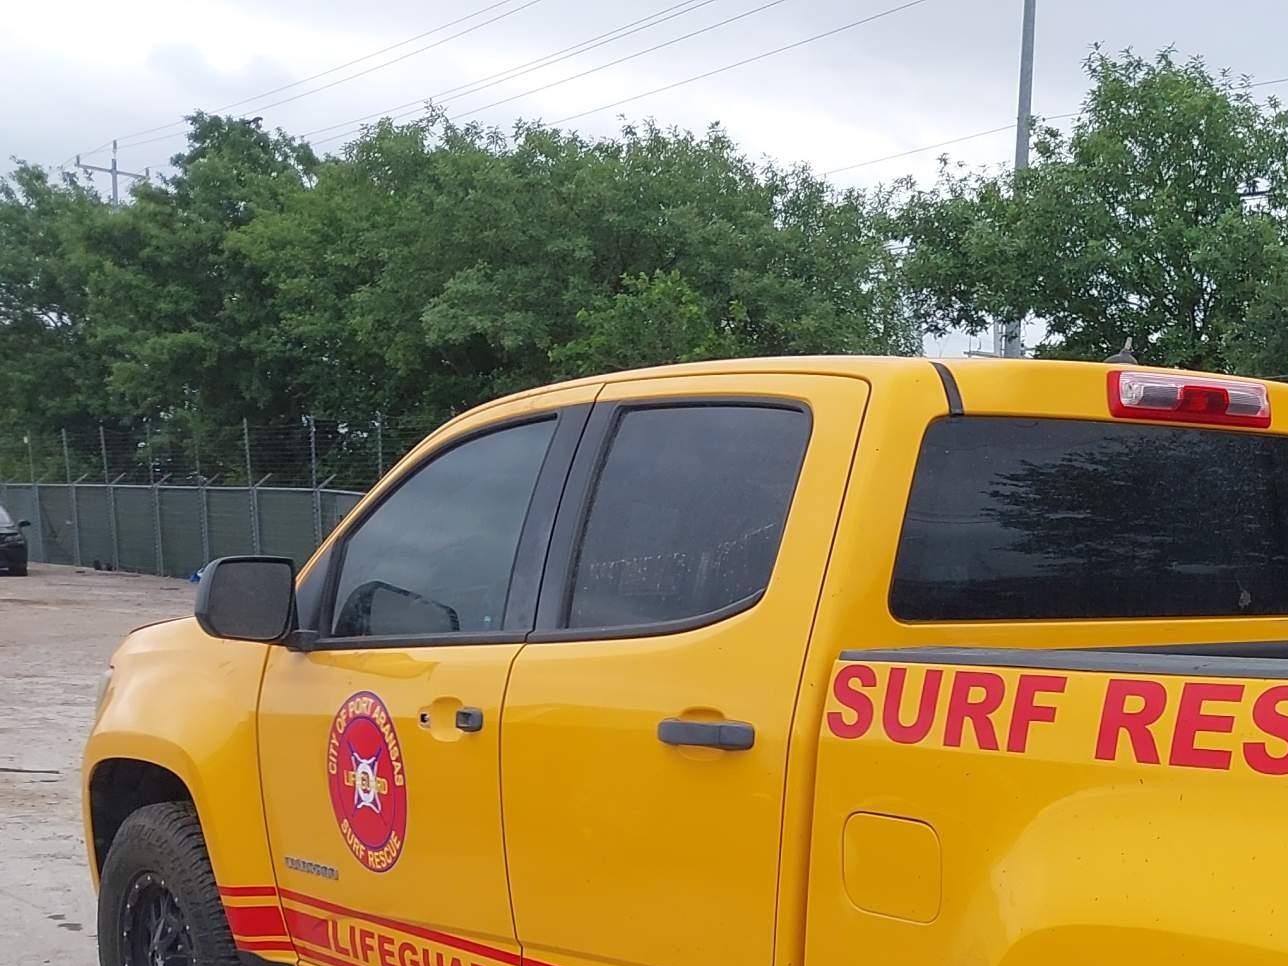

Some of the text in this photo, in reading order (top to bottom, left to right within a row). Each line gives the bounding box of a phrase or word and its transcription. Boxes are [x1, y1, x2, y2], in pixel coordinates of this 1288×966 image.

[328, 696, 405, 786] CITY OF PORT ARANSAS
[826, 664, 1067, 753] SURF
[341, 818, 367, 860] SURF
[367, 830, 401, 869] RESCUE
